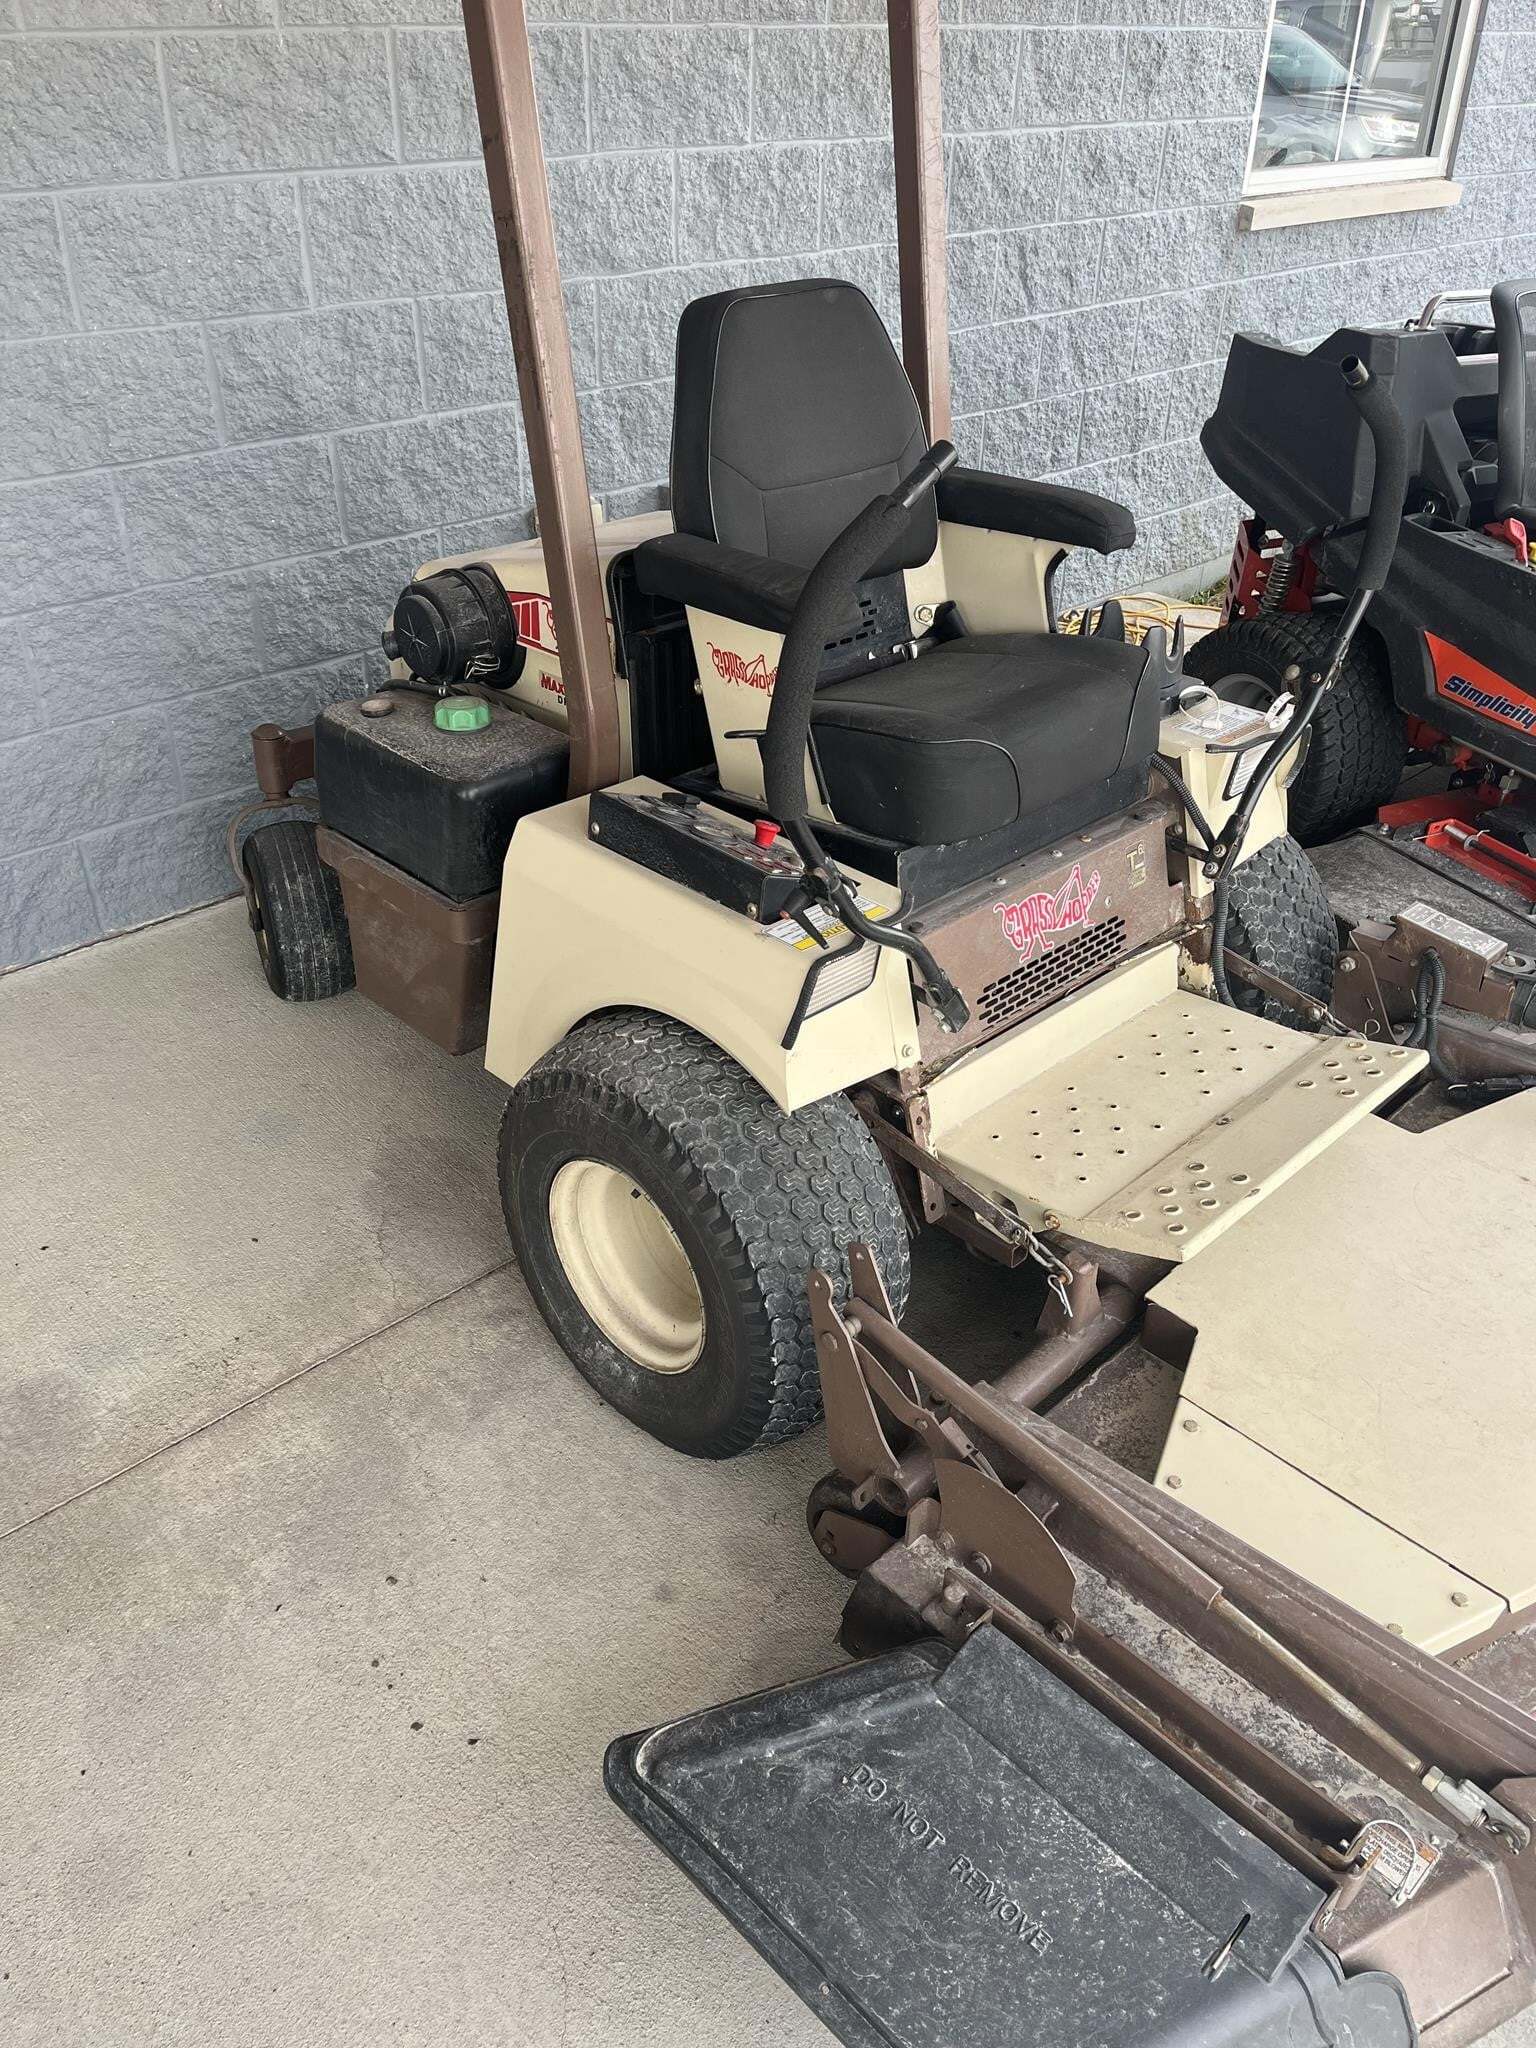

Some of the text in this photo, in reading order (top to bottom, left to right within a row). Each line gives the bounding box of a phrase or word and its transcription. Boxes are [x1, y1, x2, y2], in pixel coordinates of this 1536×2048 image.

[1443, 674, 1536, 729] Simplicity
[850, 1763, 1054, 1956] DO NOT REMOVE
